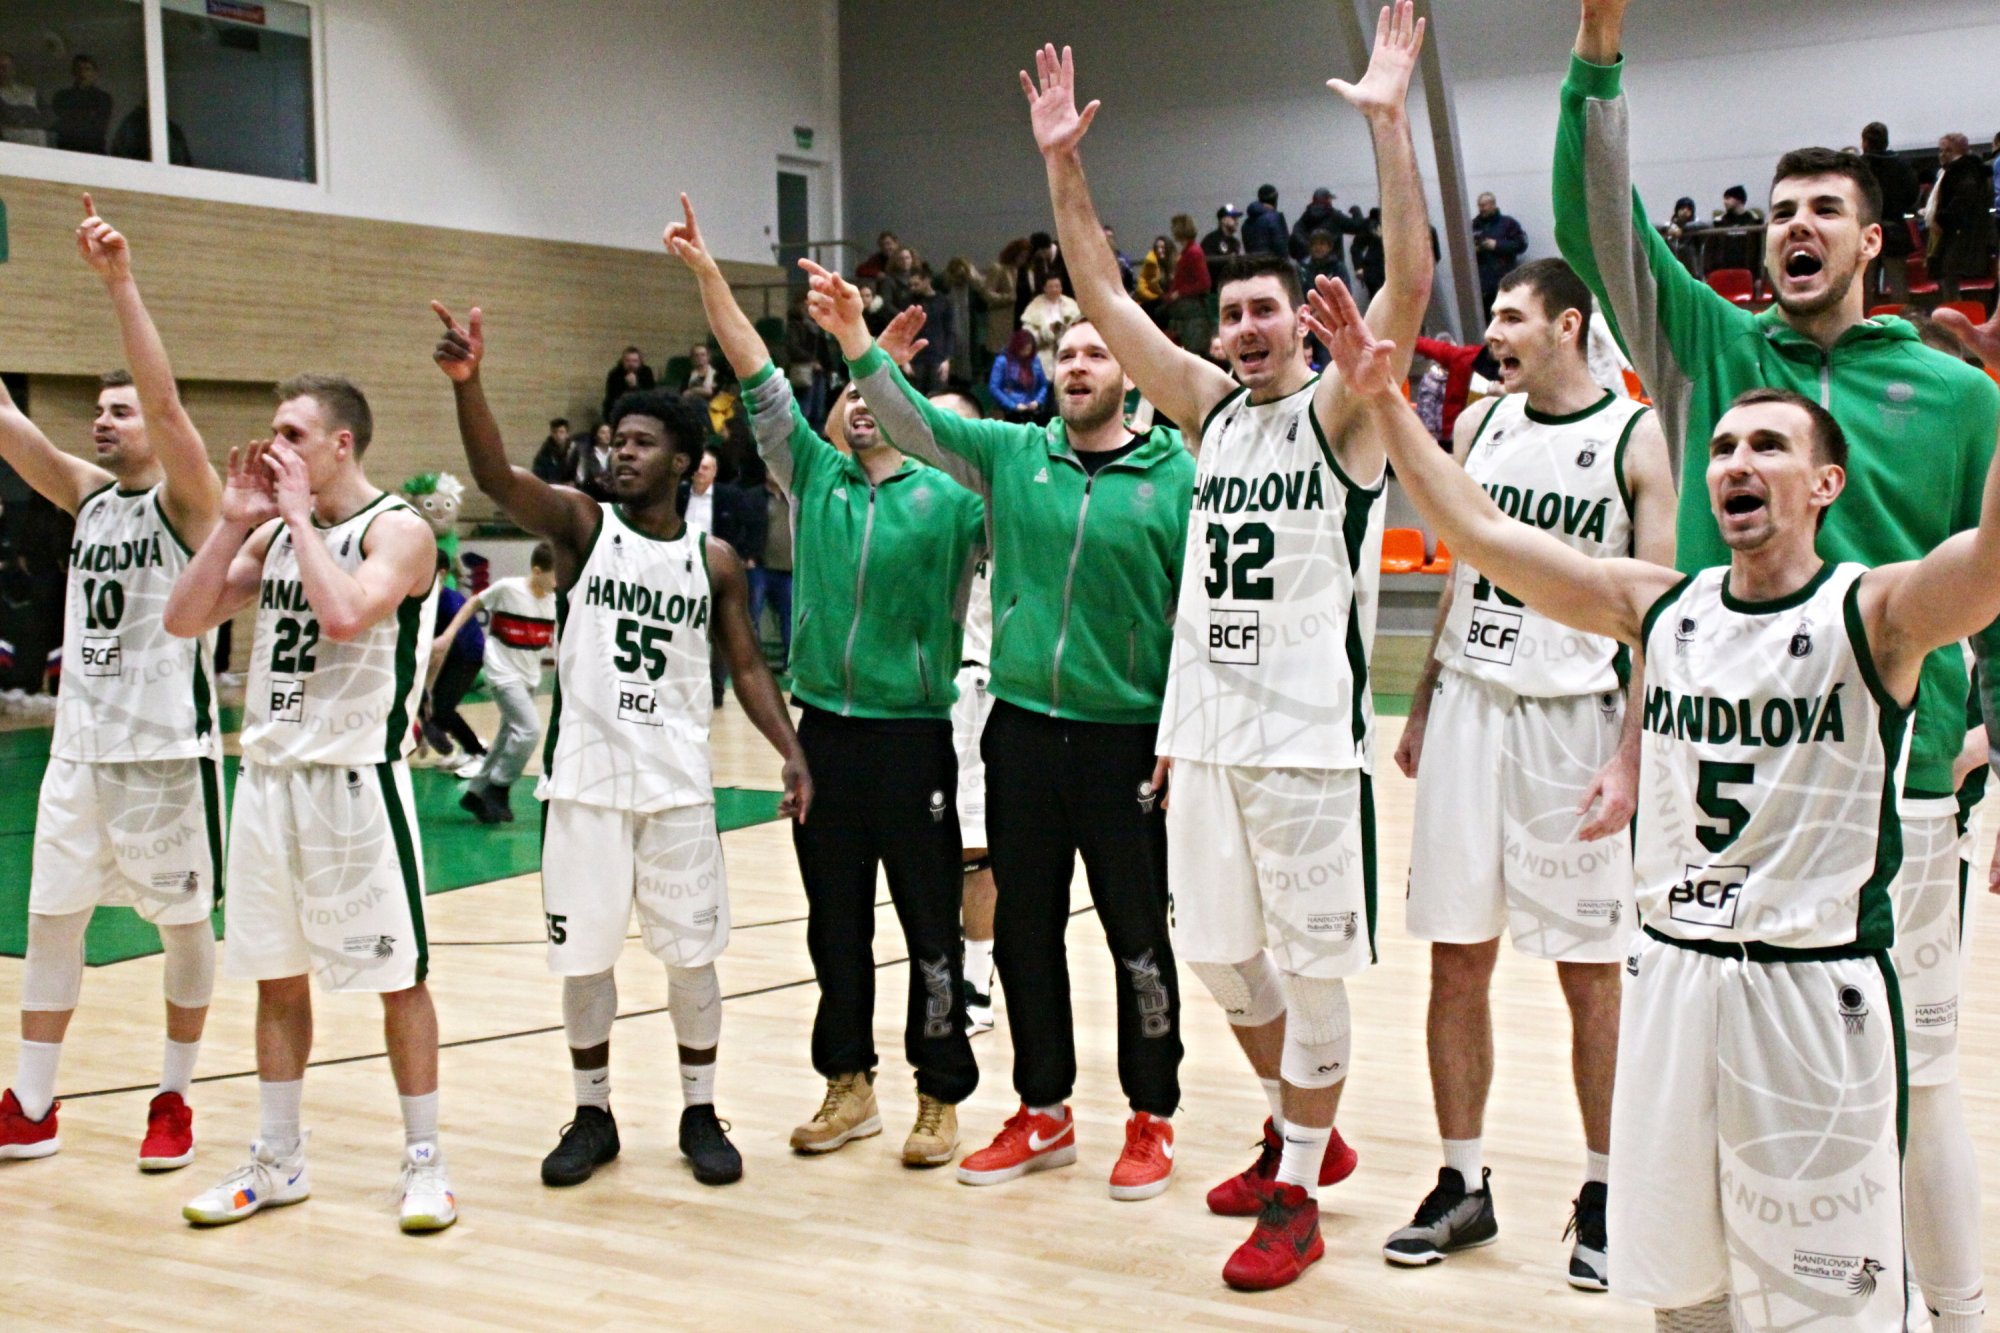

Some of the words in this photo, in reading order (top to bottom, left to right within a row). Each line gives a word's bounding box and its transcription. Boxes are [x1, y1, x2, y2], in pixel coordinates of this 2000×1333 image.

[1205, 522, 1275, 600] 32
[83, 578, 125, 630] 10
[585, 576, 708, 629] HANDLOVÁ
[82, 647, 120, 665] BCF
[271, 617, 320, 674] 22
[614, 618, 673, 682] 55
[1210, 623, 1258, 650] BCF
[1468, 620, 1520, 650] BCF
[1643, 683, 1846, 748] HANDLOVÁ
[1695, 760, 1756, 854] 5
[1669, 878, 1742, 910] BCF
